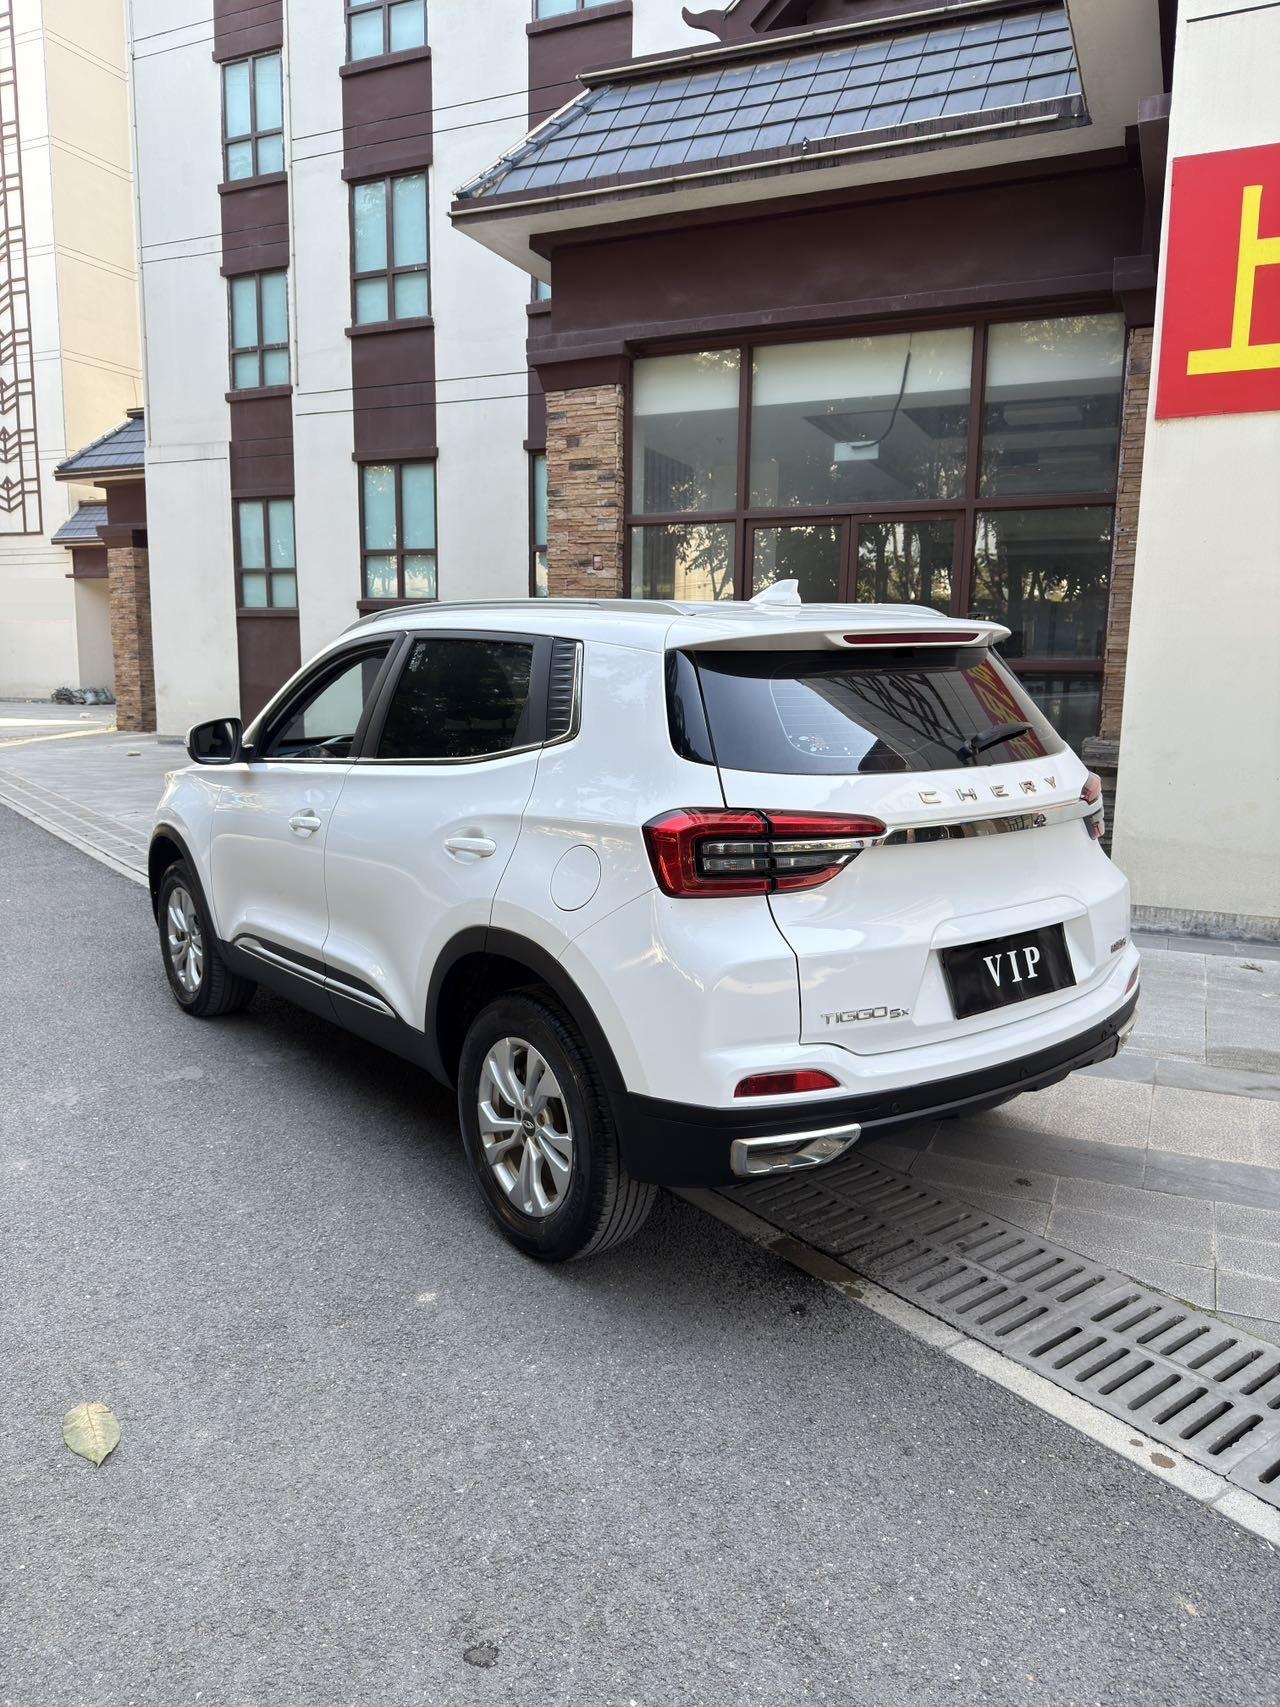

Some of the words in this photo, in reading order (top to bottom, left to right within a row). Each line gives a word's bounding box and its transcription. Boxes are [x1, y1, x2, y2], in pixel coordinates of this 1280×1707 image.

[918, 776, 1057, 804] CHERY
[983, 946, 1040, 987] VIP
[820, 1006, 888, 1024] TIGGO
